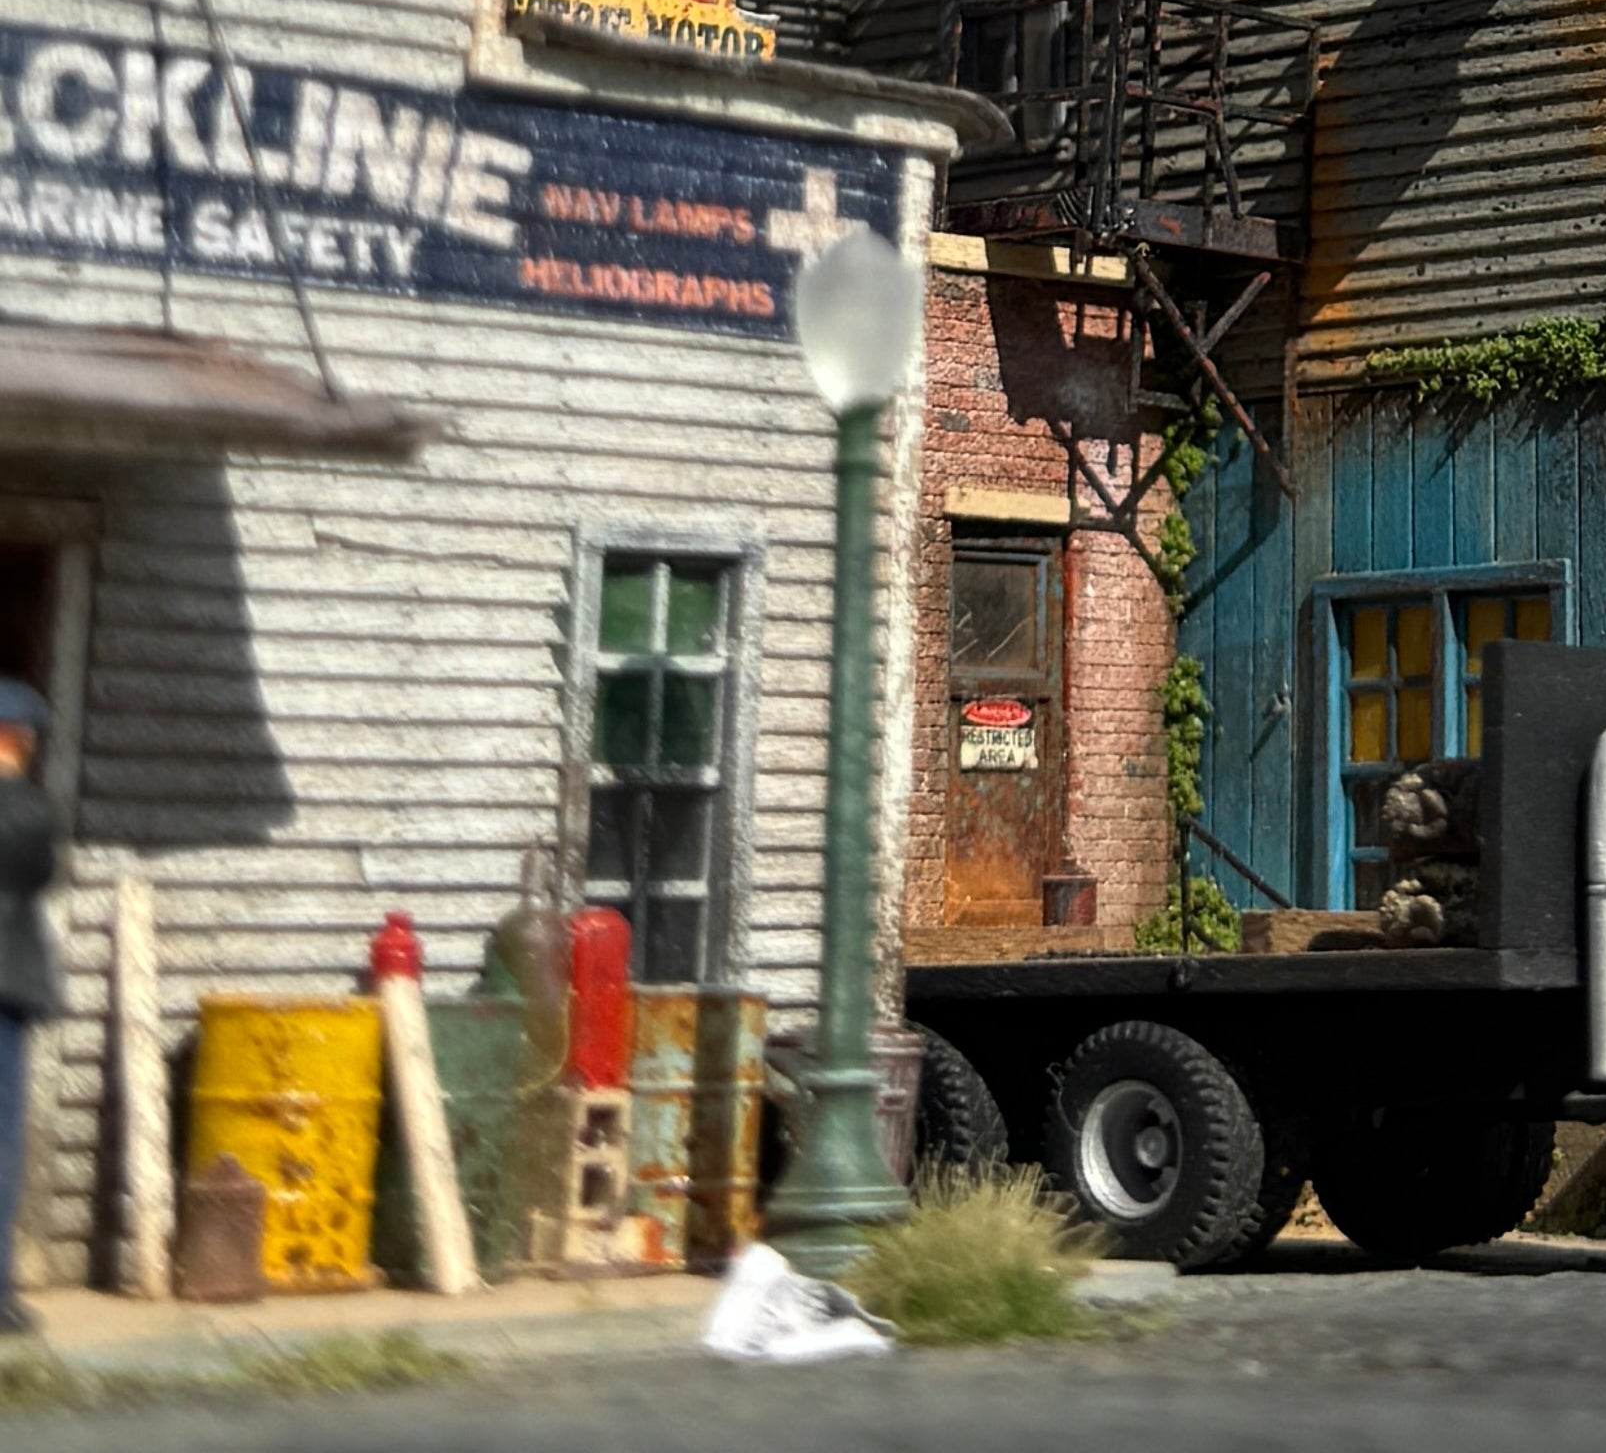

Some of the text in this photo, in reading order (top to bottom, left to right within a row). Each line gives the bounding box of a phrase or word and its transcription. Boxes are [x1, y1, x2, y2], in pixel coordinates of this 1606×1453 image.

[629, 195, 756, 245] LAMPS
[519, 256, 776, 318] HELIOGRAPHS
[967, 728, 1033, 747] RESTRICTED
[979, 749, 1015, 763] AREA
